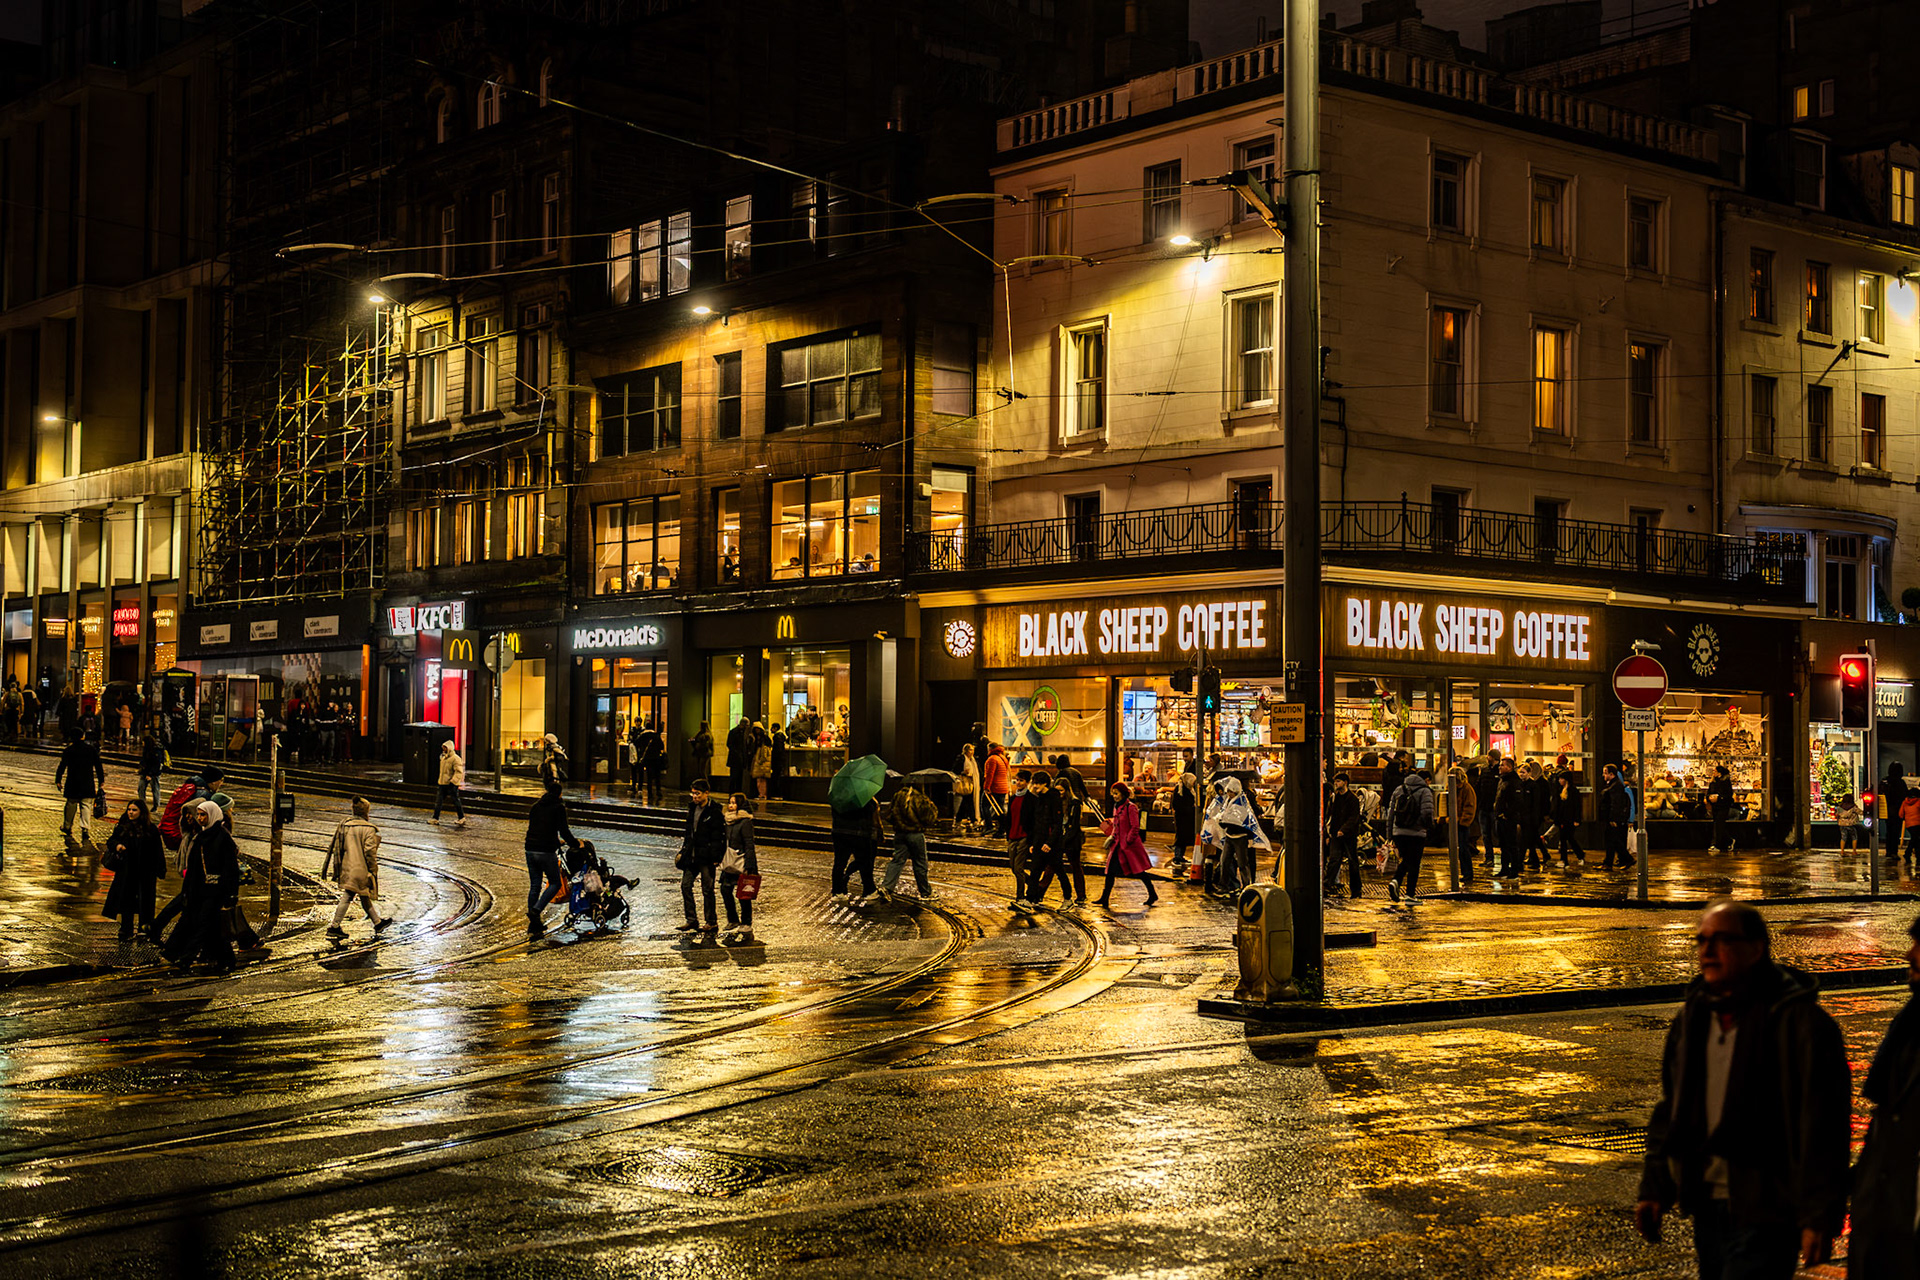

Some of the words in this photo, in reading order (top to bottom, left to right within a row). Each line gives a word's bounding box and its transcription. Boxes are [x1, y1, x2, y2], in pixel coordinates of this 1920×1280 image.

[416, 605, 450, 630] KFC
[573, 624, 658, 649] McDonald's
[1020, 611, 1088, 657] BLACK
[1099, 607, 1168, 654] SHEEP
[1178, 600, 1266, 651] COFFEE
[1347, 598, 1424, 650] BLACK
[1435, 604, 1504, 655] SHEEP
[1513, 610, 1590, 660] COFFEE
[1687, 623, 1704, 649] BLACK
[1705, 624, 1720, 652] SHEEP
[1285, 661, 1300, 669] CTY
[1288, 671, 1296, 679] 13
[1692, 659, 1716, 677] COFFEE
[426, 663, 440, 700] KFC
[1272, 716, 1303, 724] Emergency
[1273, 706, 1302, 714] CAUTION
[1627, 713, 1653, 721] Except
